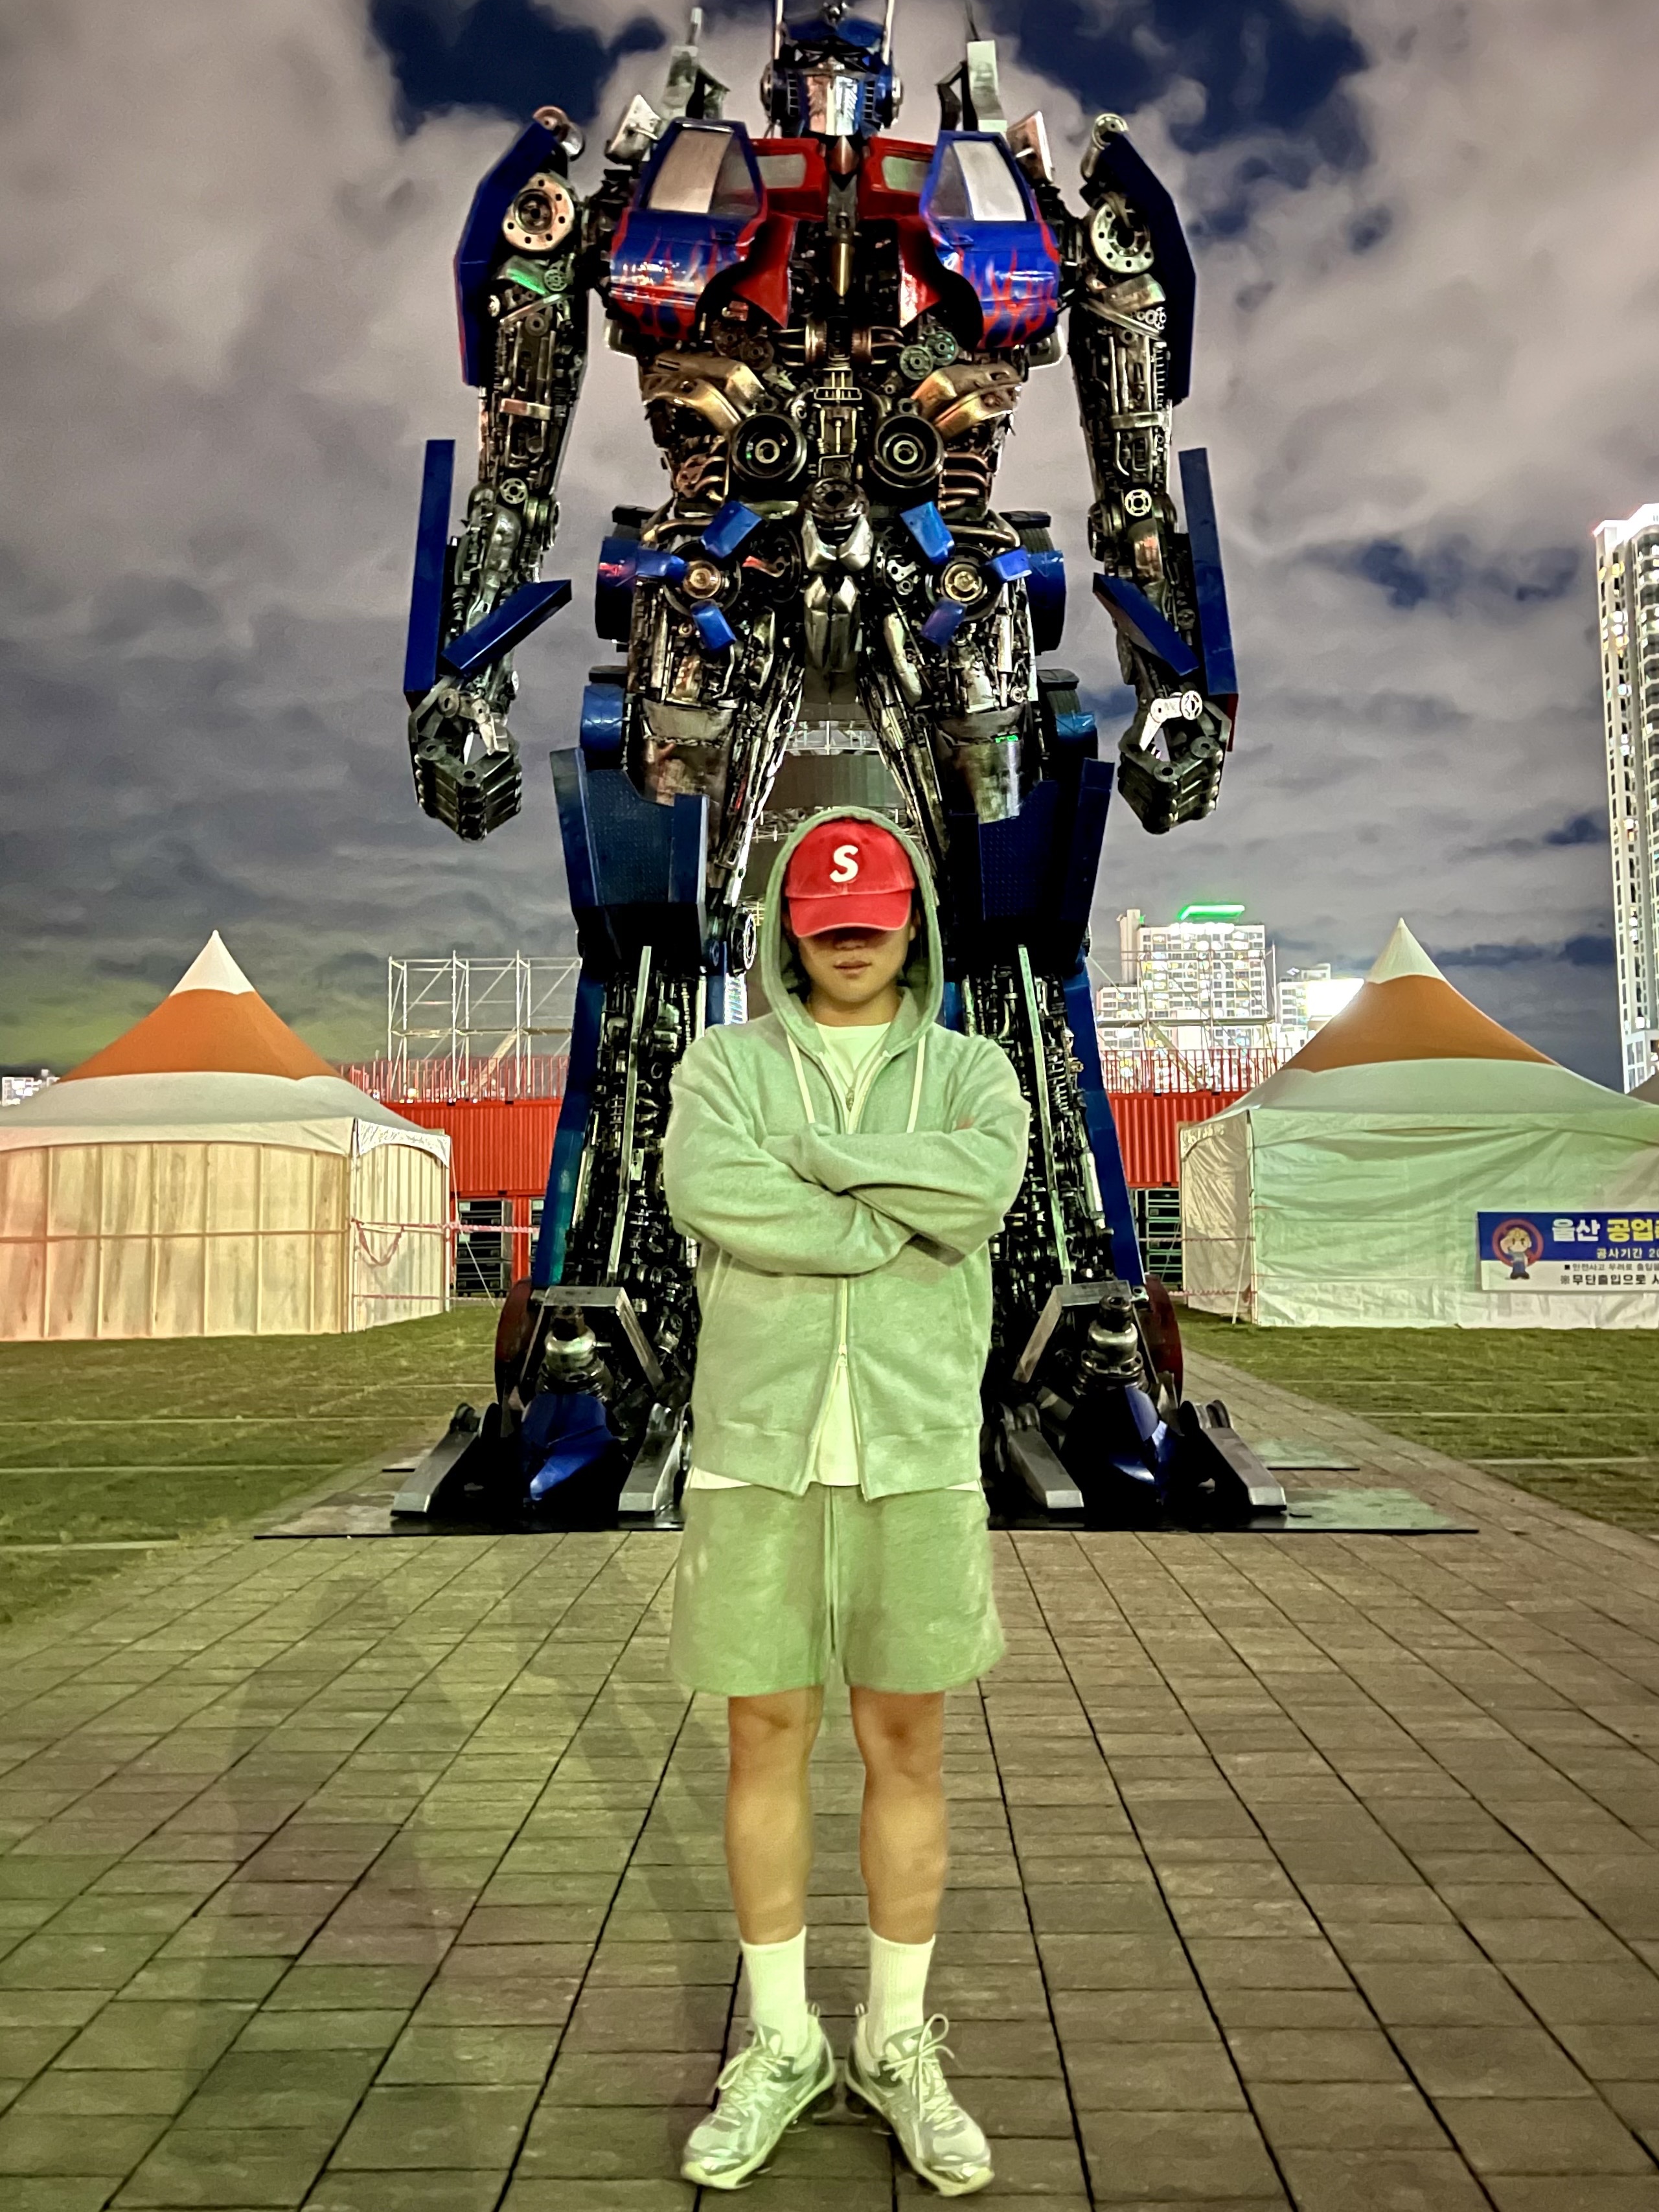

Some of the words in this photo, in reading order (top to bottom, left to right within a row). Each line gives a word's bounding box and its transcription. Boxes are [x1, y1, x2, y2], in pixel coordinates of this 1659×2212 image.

[829, 845, 859, 883] S
[1551, 1218, 1601, 1242] 울산
[1607, 1218, 1659, 1242] 공업
[1596, 1248, 1643, 1259] 공사기간
[1572, 1274, 1646, 1285] 무단출입으로
